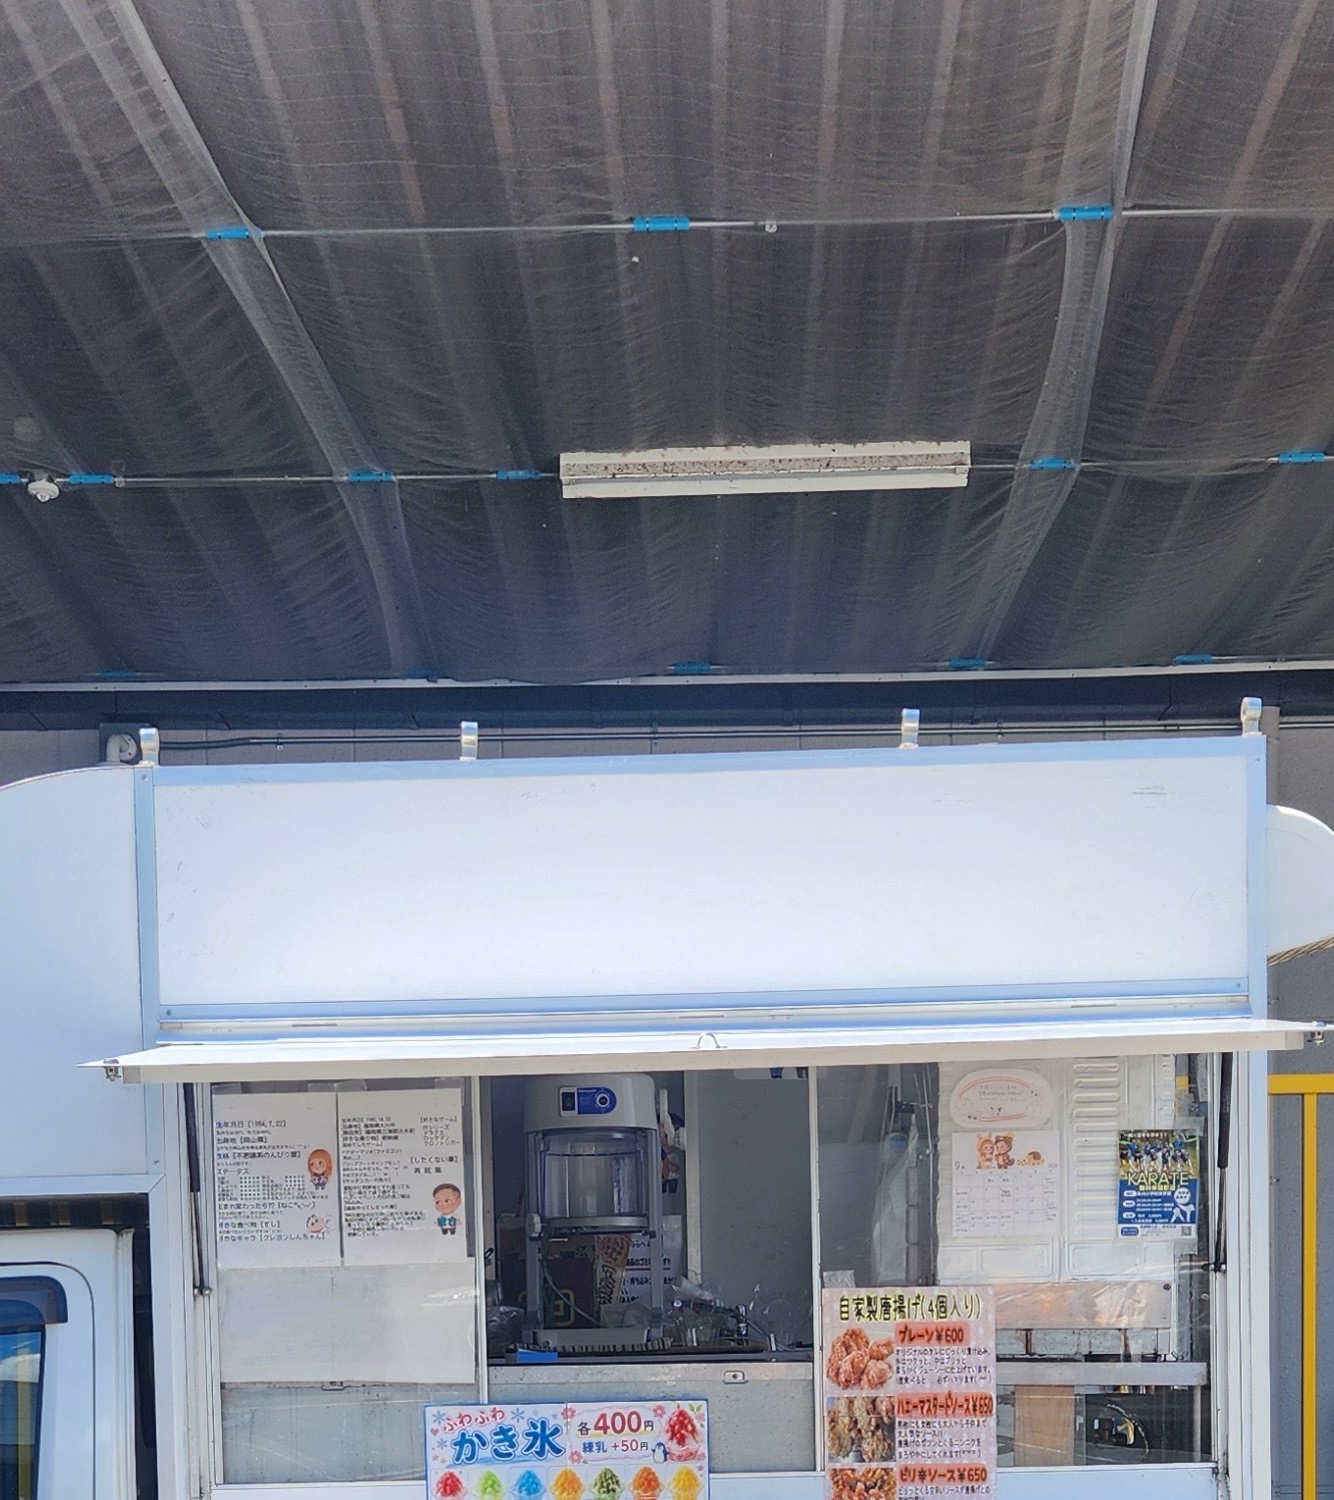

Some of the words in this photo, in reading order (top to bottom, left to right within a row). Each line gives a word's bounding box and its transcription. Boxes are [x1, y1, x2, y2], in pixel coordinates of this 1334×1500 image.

[1127, 1172, 1189, 1186] KARATE
[839, 1293, 981, 1321] 自家製唐揚げ(4個入り)
[444, 1407, 505, 1432] ふわふわ
[452, 1418, 566, 1464] かき氷
